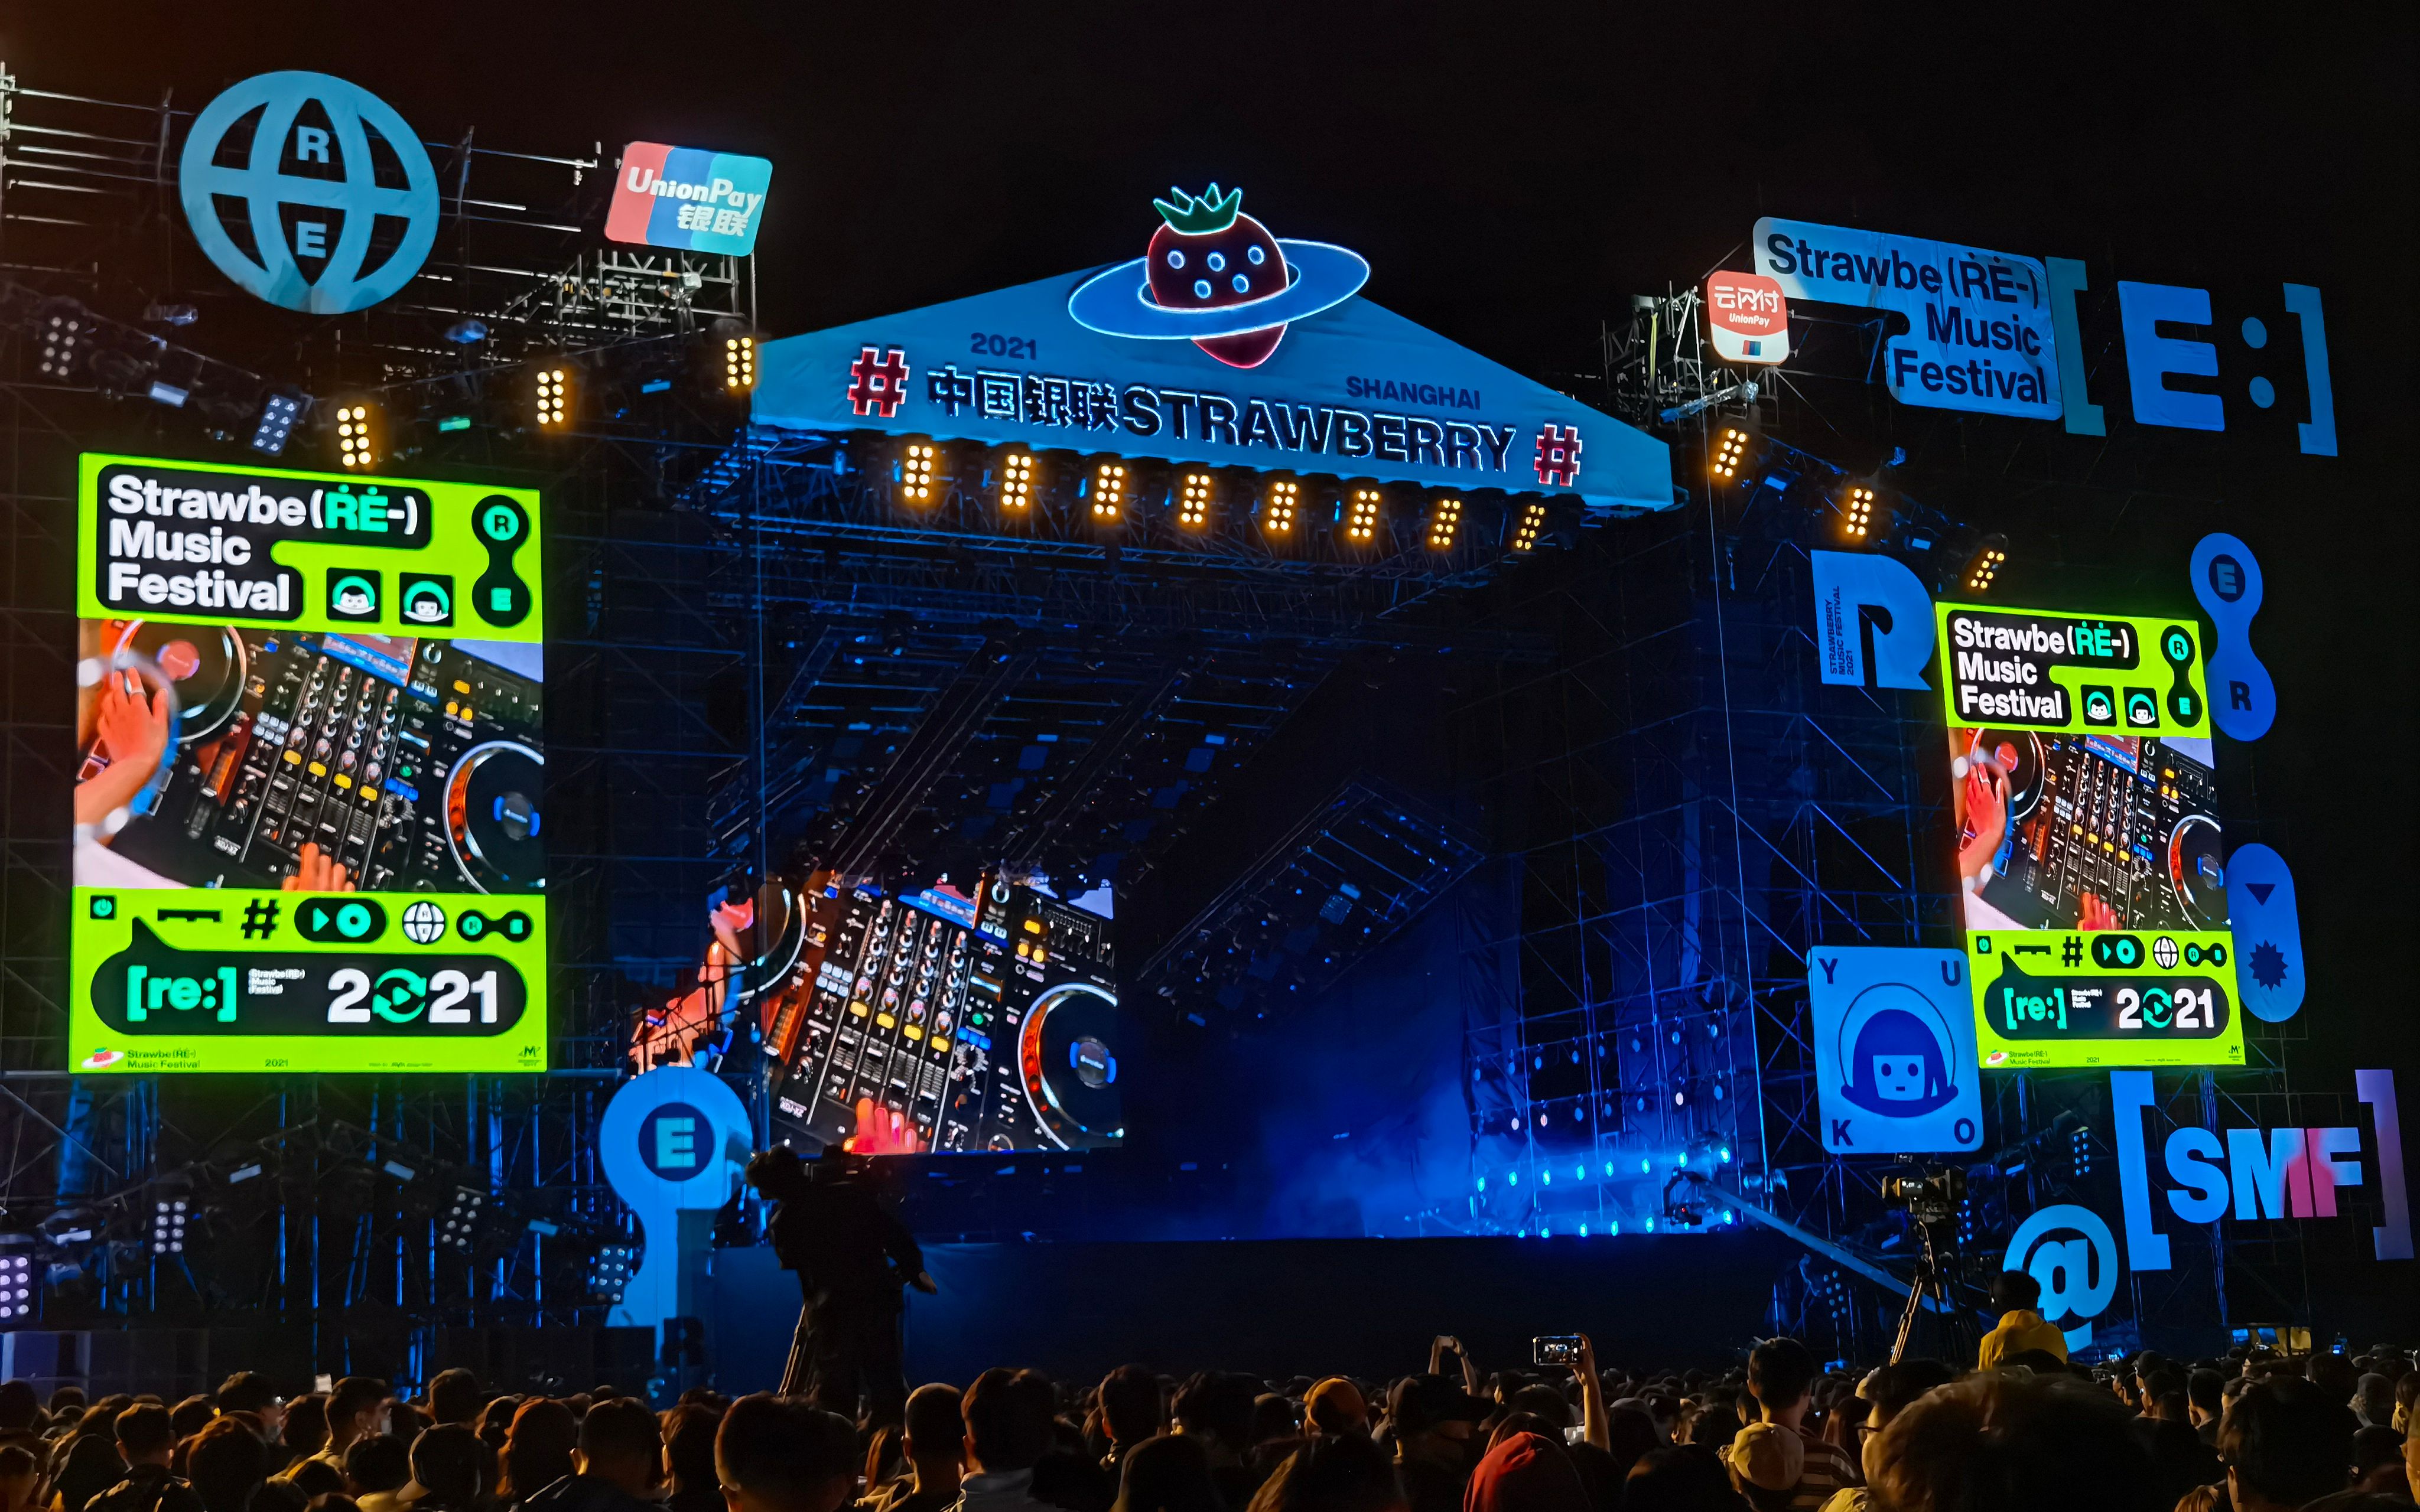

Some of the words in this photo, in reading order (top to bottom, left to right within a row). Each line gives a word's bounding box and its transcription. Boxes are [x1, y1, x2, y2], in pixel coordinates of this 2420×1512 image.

[297, 125, 330, 164] R
[627, 167, 762, 218] UnionPay
[678, 204, 749, 237] 银联
[297, 220, 327, 258] E
[1714, 285, 1780, 313] 云网付
[1729, 312, 1770, 328] UnionPay
[1926, 302, 2041, 357] Music
[970, 332, 1037, 361] 2021
[1345, 375, 1481, 410] SHANGHAI
[1892, 347, 2048, 404] Festival
[494, 514, 509, 533] R
[109, 519, 251, 566] Music
[108, 562, 290, 612] Festival
[2216, 563, 2237, 594] E
[1833, 585, 1844, 637] FESTIVAL
[1824, 599, 1837, 674] STRAWBERRY
[2173, 640, 2184, 656] R
[1836, 639, 1846, 675] MUSIC
[1845, 650, 1854, 676] 2021
[1958, 652, 2038, 686] Music
[1960, 685, 2064, 720] Festival
[2229, 680, 2252, 712] R
[126, 964, 237, 1023] [re:]
[2003, 988, 2068, 1030] [re:]
[265, 1058, 289, 1068] 2021
[656, 1117, 696, 1169] E
